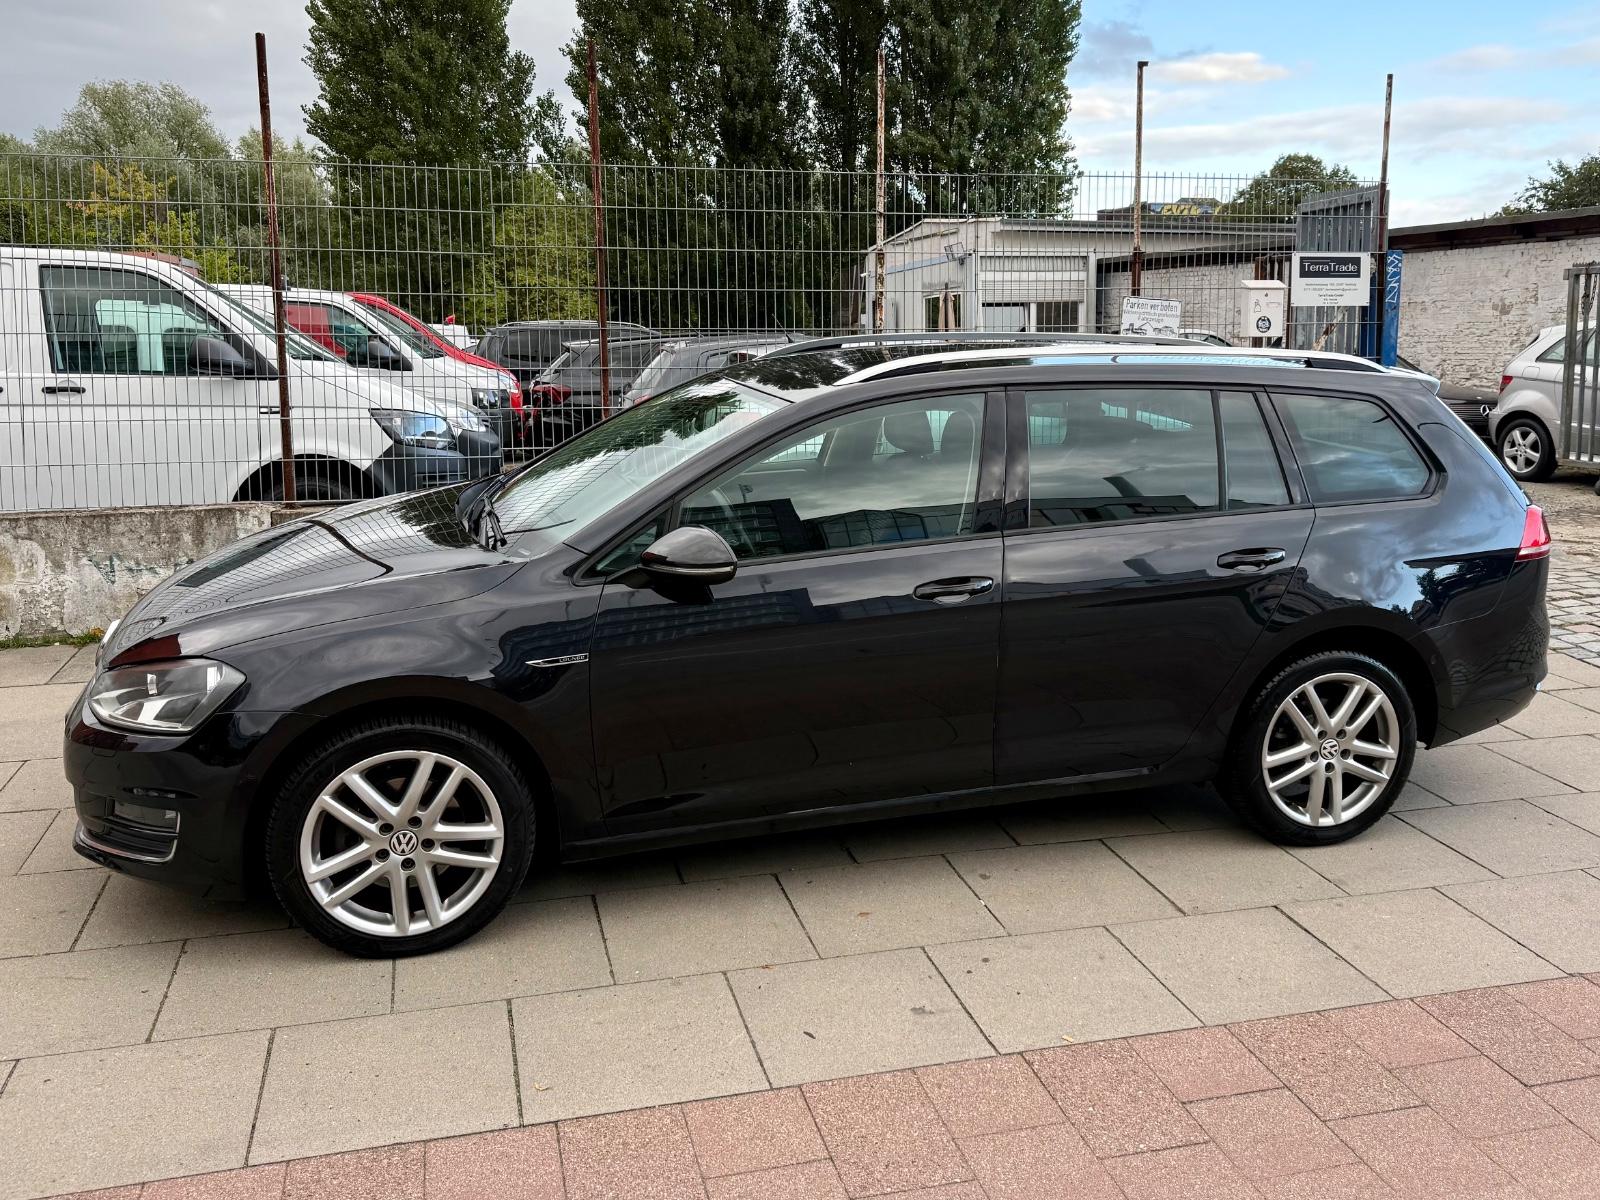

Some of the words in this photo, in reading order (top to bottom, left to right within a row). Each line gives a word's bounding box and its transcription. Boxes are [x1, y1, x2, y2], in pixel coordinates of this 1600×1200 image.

[1302, 262, 1358, 272] TerraTrade
[1126, 298, 1149, 309] Parken
[1150, 302, 1178, 312] verboten
